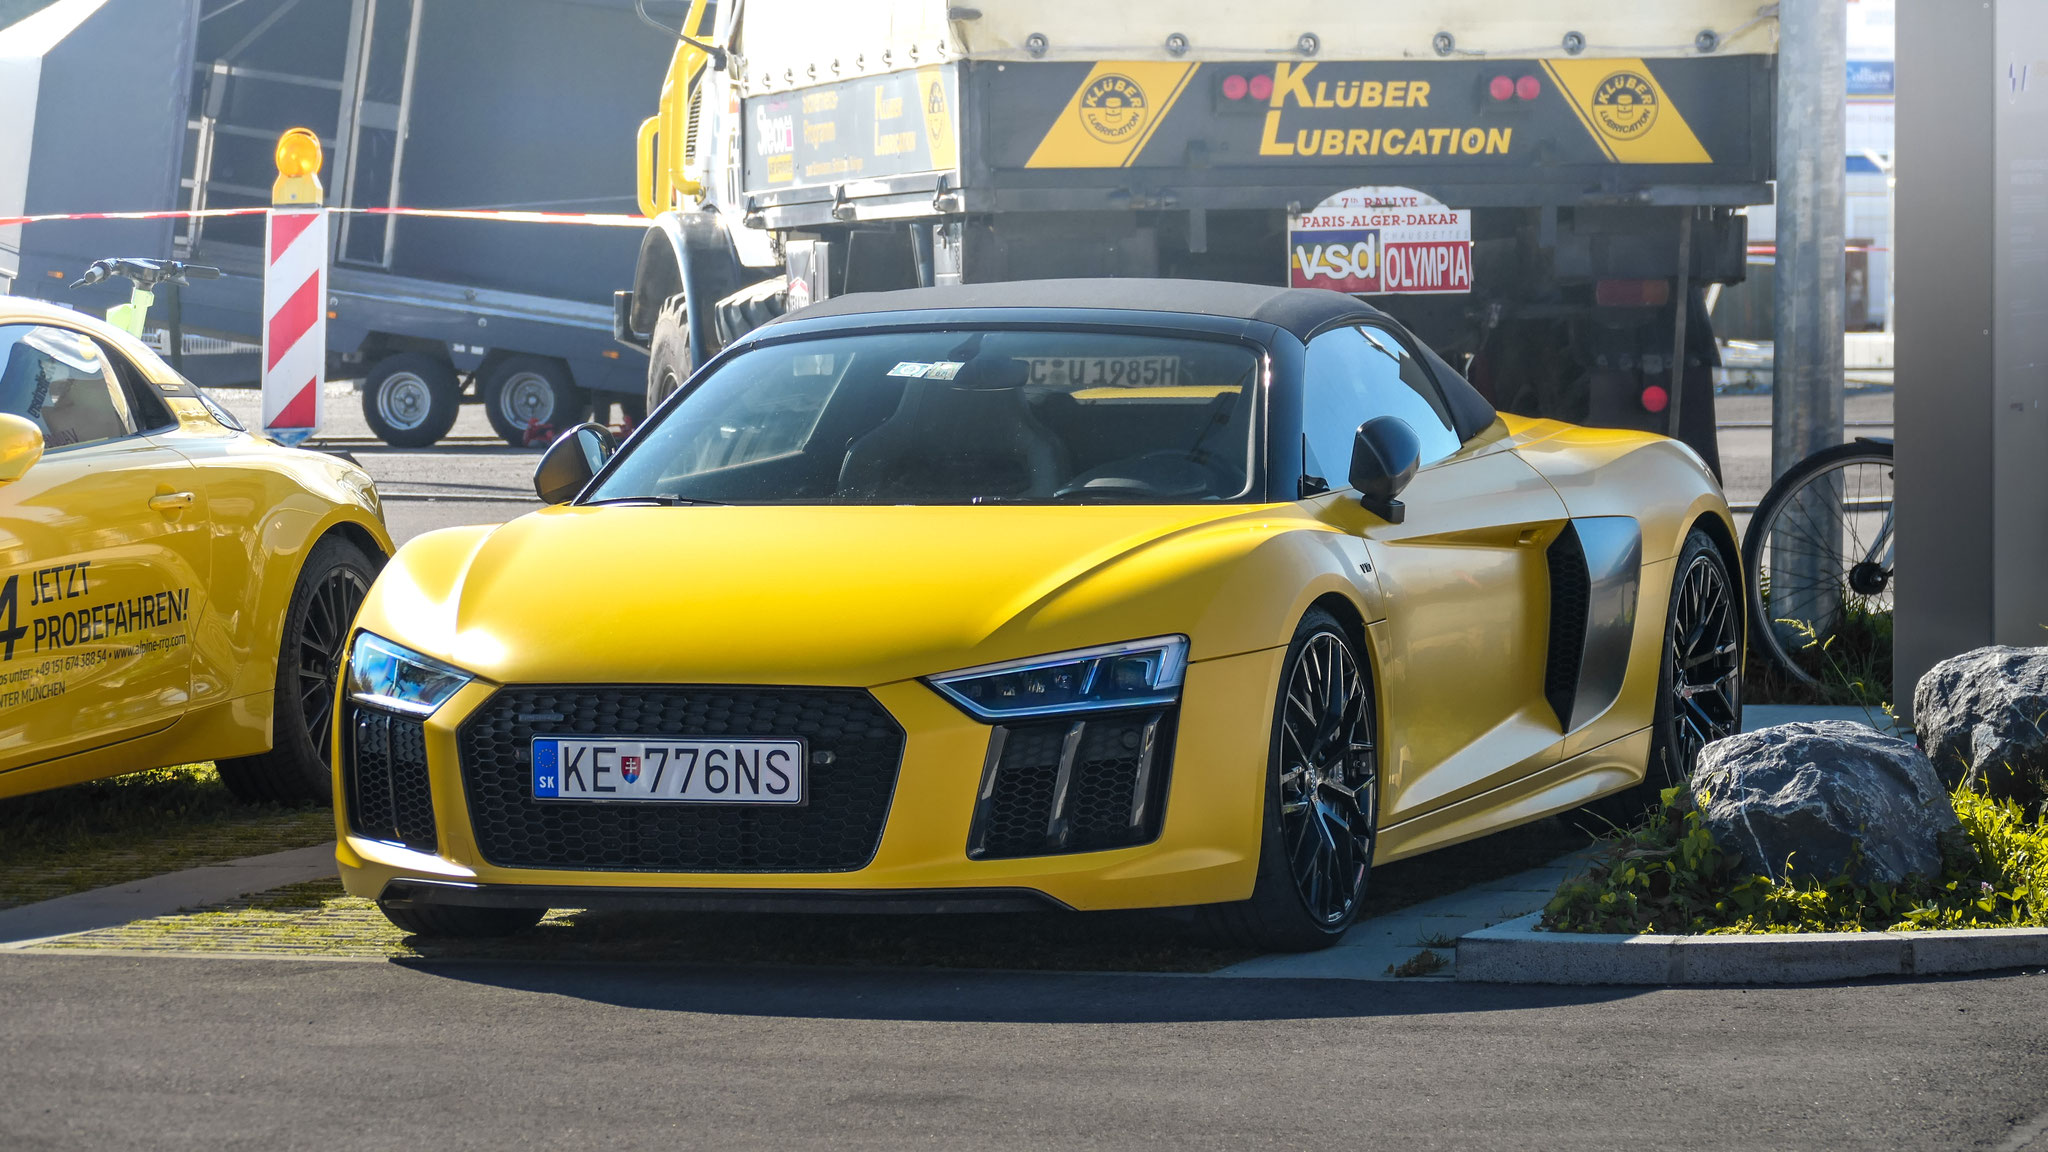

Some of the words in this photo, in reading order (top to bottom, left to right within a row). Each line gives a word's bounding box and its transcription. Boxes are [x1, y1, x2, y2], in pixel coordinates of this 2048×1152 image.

[1086, 79, 1143, 108] KLÜBER
[1599, 76, 1653, 105] KLÜBER
[1088, 112, 1140, 137] LUBRICATION
[1259, 110, 1512, 156] LUBRICATION
[1600, 109, 1651, 133] LUBRICATION
[1364, 197, 1418, 208] RALLYE
[1302, 213, 1458, 228] PARIS-ALGER-DAKAR
[1296, 232, 1376, 281] vsd
[1385, 246, 1468, 288] OLYMPIA
[31, 561, 91, 606] JETZT
[33, 588, 190, 654] PROBEFAHREN!
[21, 680, 66, 704] MÜNCHEN
[539, 776, 554, 788] SK
[563, 746, 616, 793] KE
[644, 747, 791, 795] 776NS
